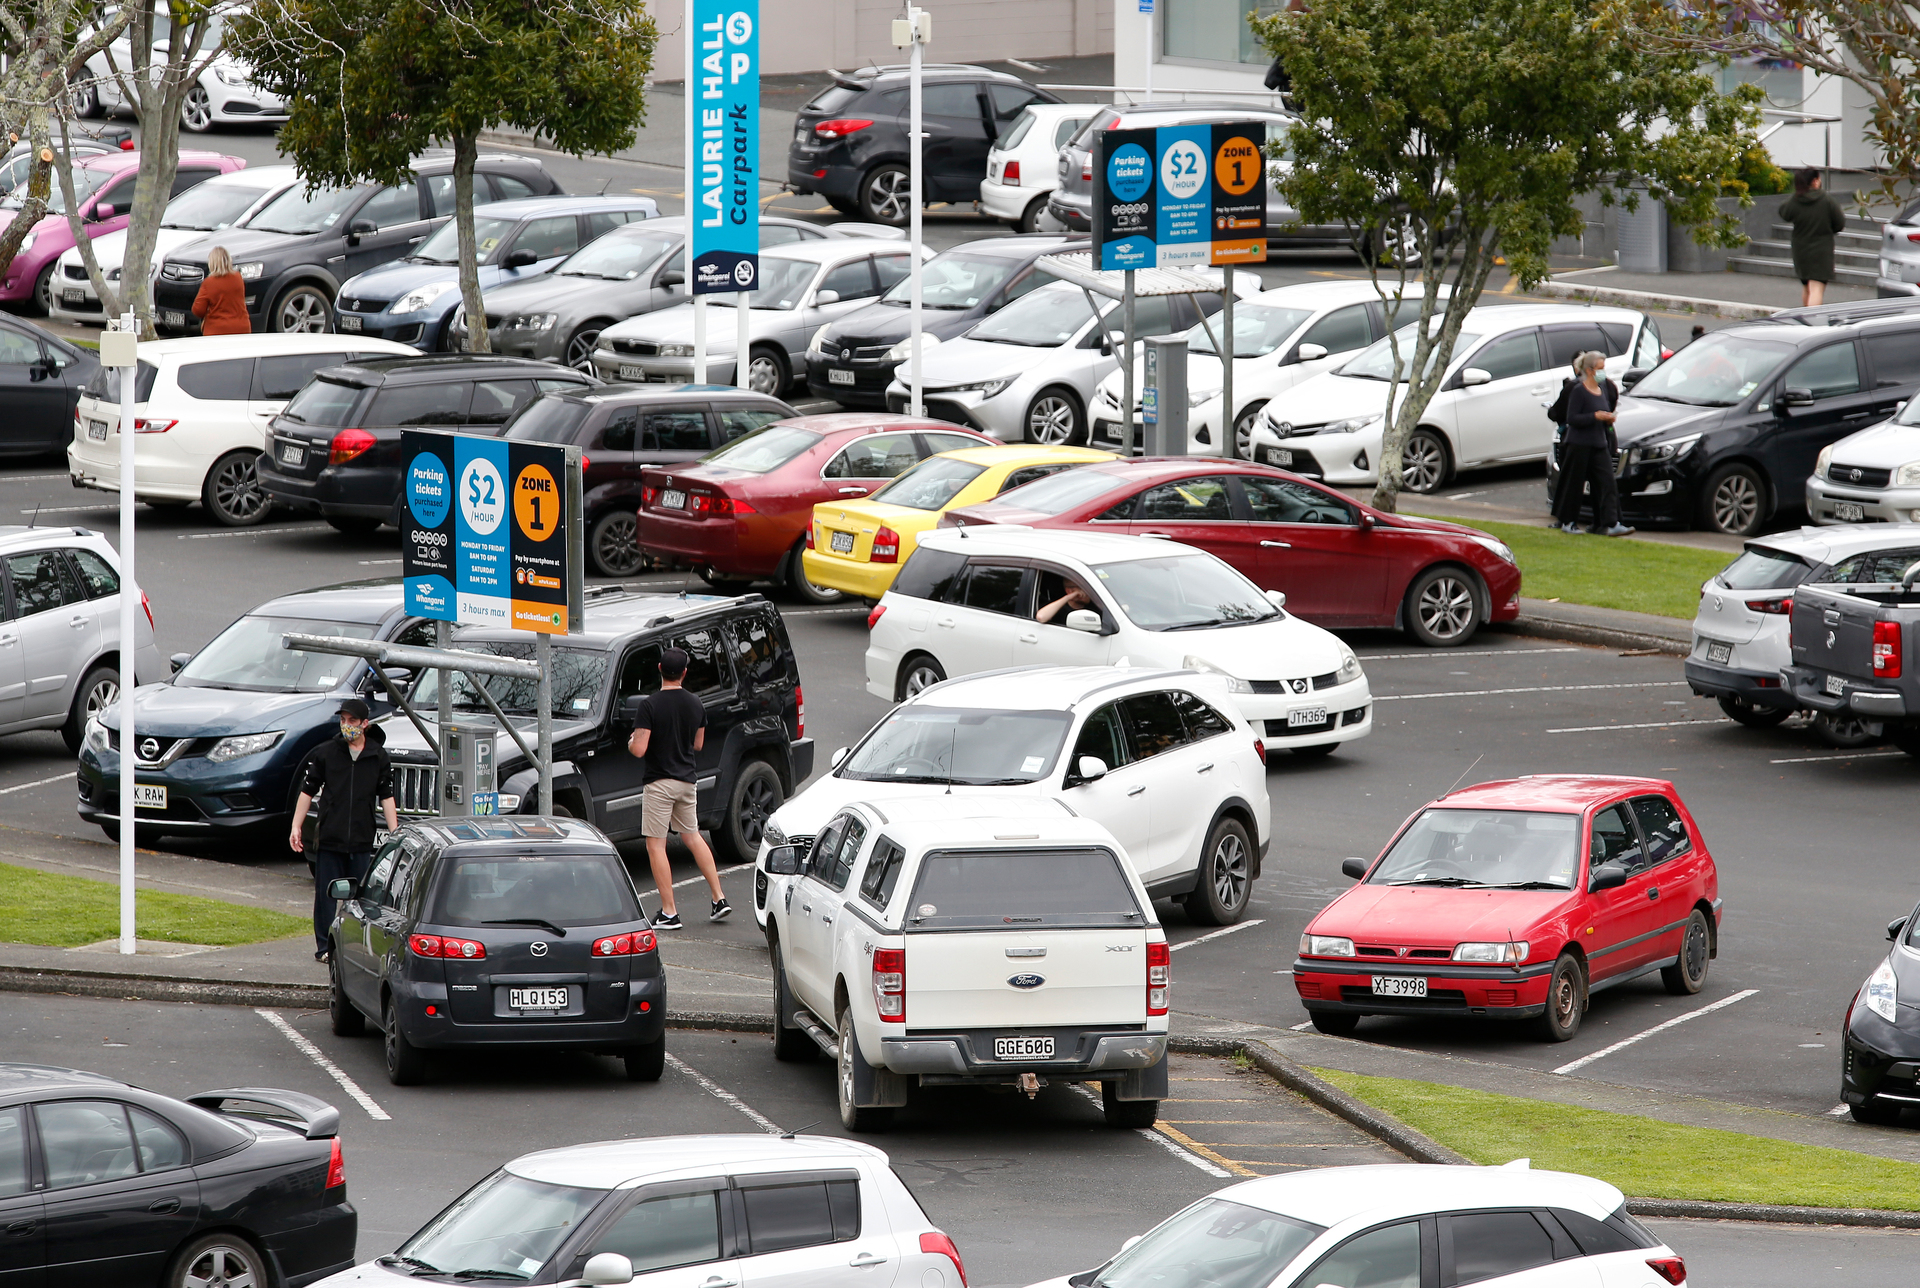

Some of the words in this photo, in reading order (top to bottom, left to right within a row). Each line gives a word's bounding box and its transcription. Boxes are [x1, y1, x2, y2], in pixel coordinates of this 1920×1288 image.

[702, 13, 724, 100] HALL
[731, 52, 750, 85] P
[1223, 146, 1252, 158] ZONE
[728, 102, 752, 226] Carpark
[1114, 155, 1145, 167] Parking
[1170, 149, 1197, 179] $2
[702, 107, 724, 229] LAURIE
[1116, 167, 1144, 178] tickets
[1231, 161, 1245, 187] 1
[1172, 180, 1196, 191] /HOUR
[1162, 251, 1167, 260] 3
[1168, 251, 1189, 260] hours
[1189, 251, 1205, 259] max
[697, 271, 731, 283] Whangarei
[1148, 351, 1156, 366] P
[1143, 395, 1156, 405] NO
[413, 467, 444, 484] Parking
[415, 482, 443, 496] tickets
[468, 468, 496, 508] $2
[521, 476, 551, 493] ZONE
[414, 498, 443, 508] purchased
[422, 507, 436, 518] here
[470, 510, 495, 523] /HOUR
[530, 496, 544, 531] 1
[460, 541, 481, 550] MONDAY
[481, 543, 488, 551] TO
[488, 544, 506, 553] FRIDAY
[469, 552, 480, 560] 8AM
[480, 553, 487, 561] TO
[486, 554, 498, 562] 6PM
[514, 554, 523, 563] Pay
[523, 555, 529, 564] by
[529, 557, 554, 566] smartphone
[471, 565, 496, 574] SATURDAY
[469, 575, 480, 583] 8AM
[480, 576, 487, 584] TO
[487, 577, 498, 585] 2PM
[415, 594, 445, 606] Whangarei
[462, 602, 467, 613] 3
[468, 603, 489, 616] hours
[490, 608, 506, 618] max
[515, 611, 523, 619] Go
[523, 611, 551, 623] ticketless!
[1290, 709, 1326, 725] JTH369
[390, 748, 409, 756] Jeep
[478, 743, 491, 763] P
[145, 787, 164, 801] RAW
[474, 795, 483, 803] Go
[483, 794, 494, 802] for
[474, 802, 493, 815] NO
[1015, 974, 1038, 985] Ford
[1373, 978, 1426, 995] XF3998
[511, 990, 567, 1006] HLQ153
[996, 1039, 1053, 1055] GGE606
